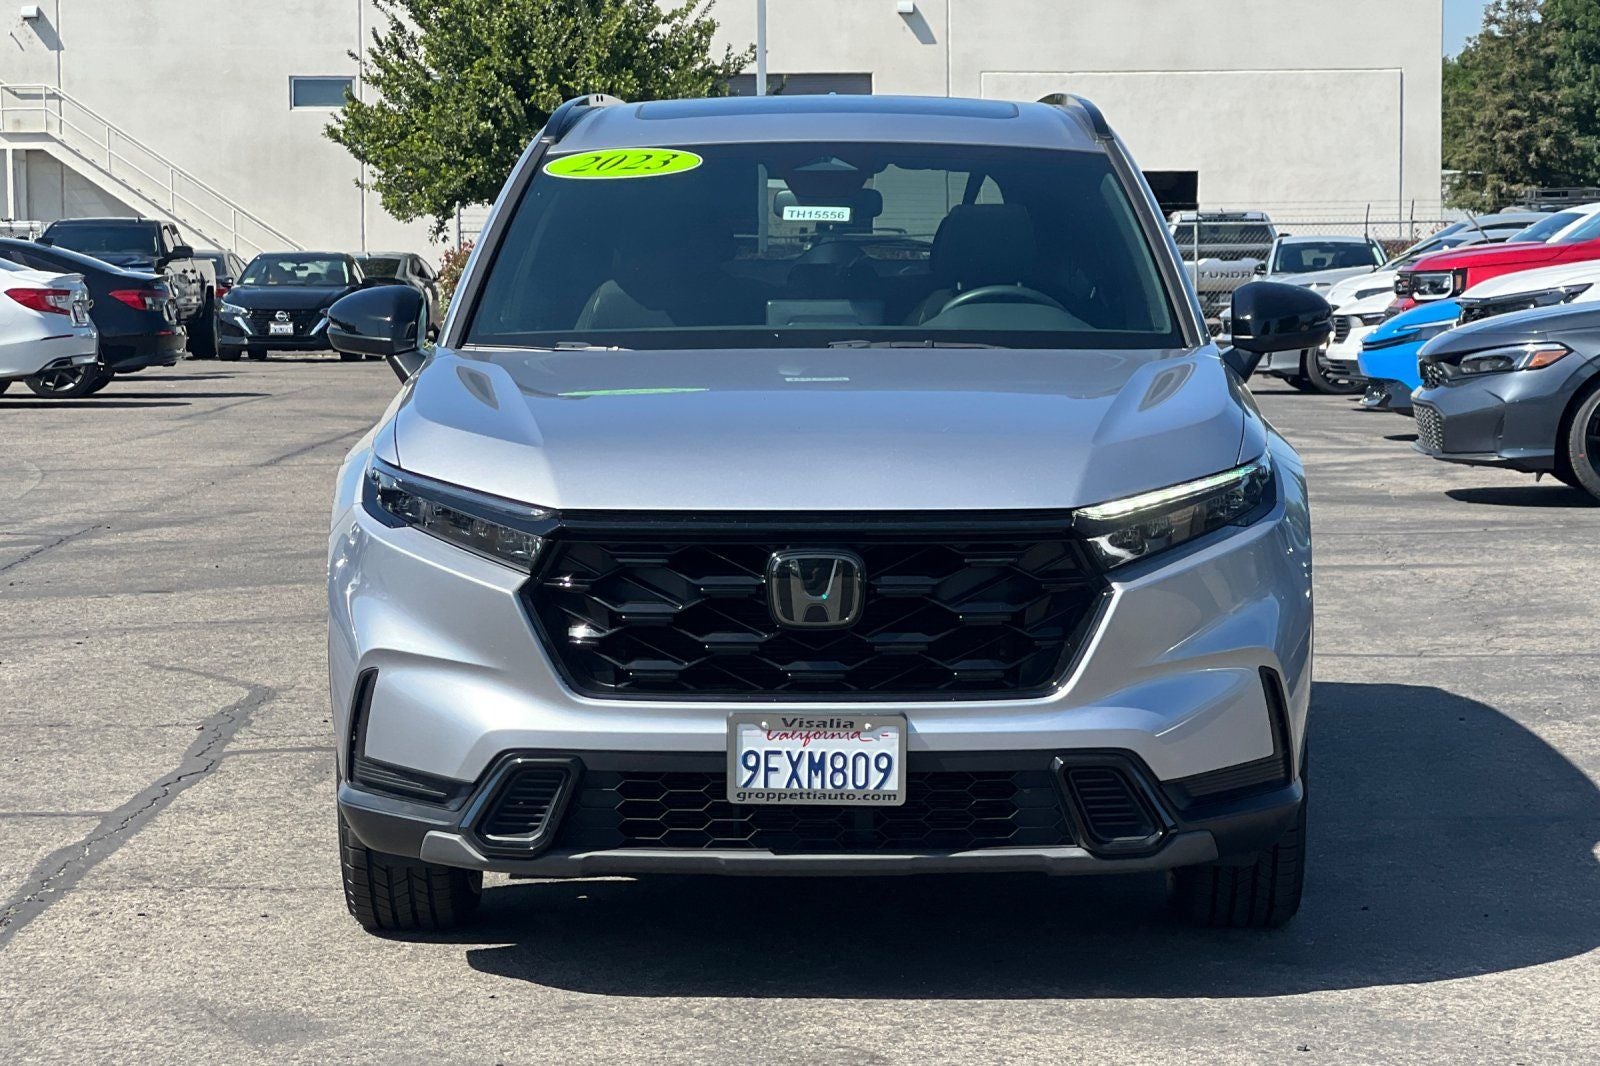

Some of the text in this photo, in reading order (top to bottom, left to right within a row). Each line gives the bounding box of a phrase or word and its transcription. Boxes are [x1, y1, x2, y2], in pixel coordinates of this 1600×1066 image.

[570, 153, 680, 173] 2023
[788, 209, 845, 219] TH15556
[781, 717, 855, 729] Visalia
[767, 730, 872, 747] California
[741, 750, 893, 790] 9FXM809
[736, 790, 897, 802] groppettiauto.com
